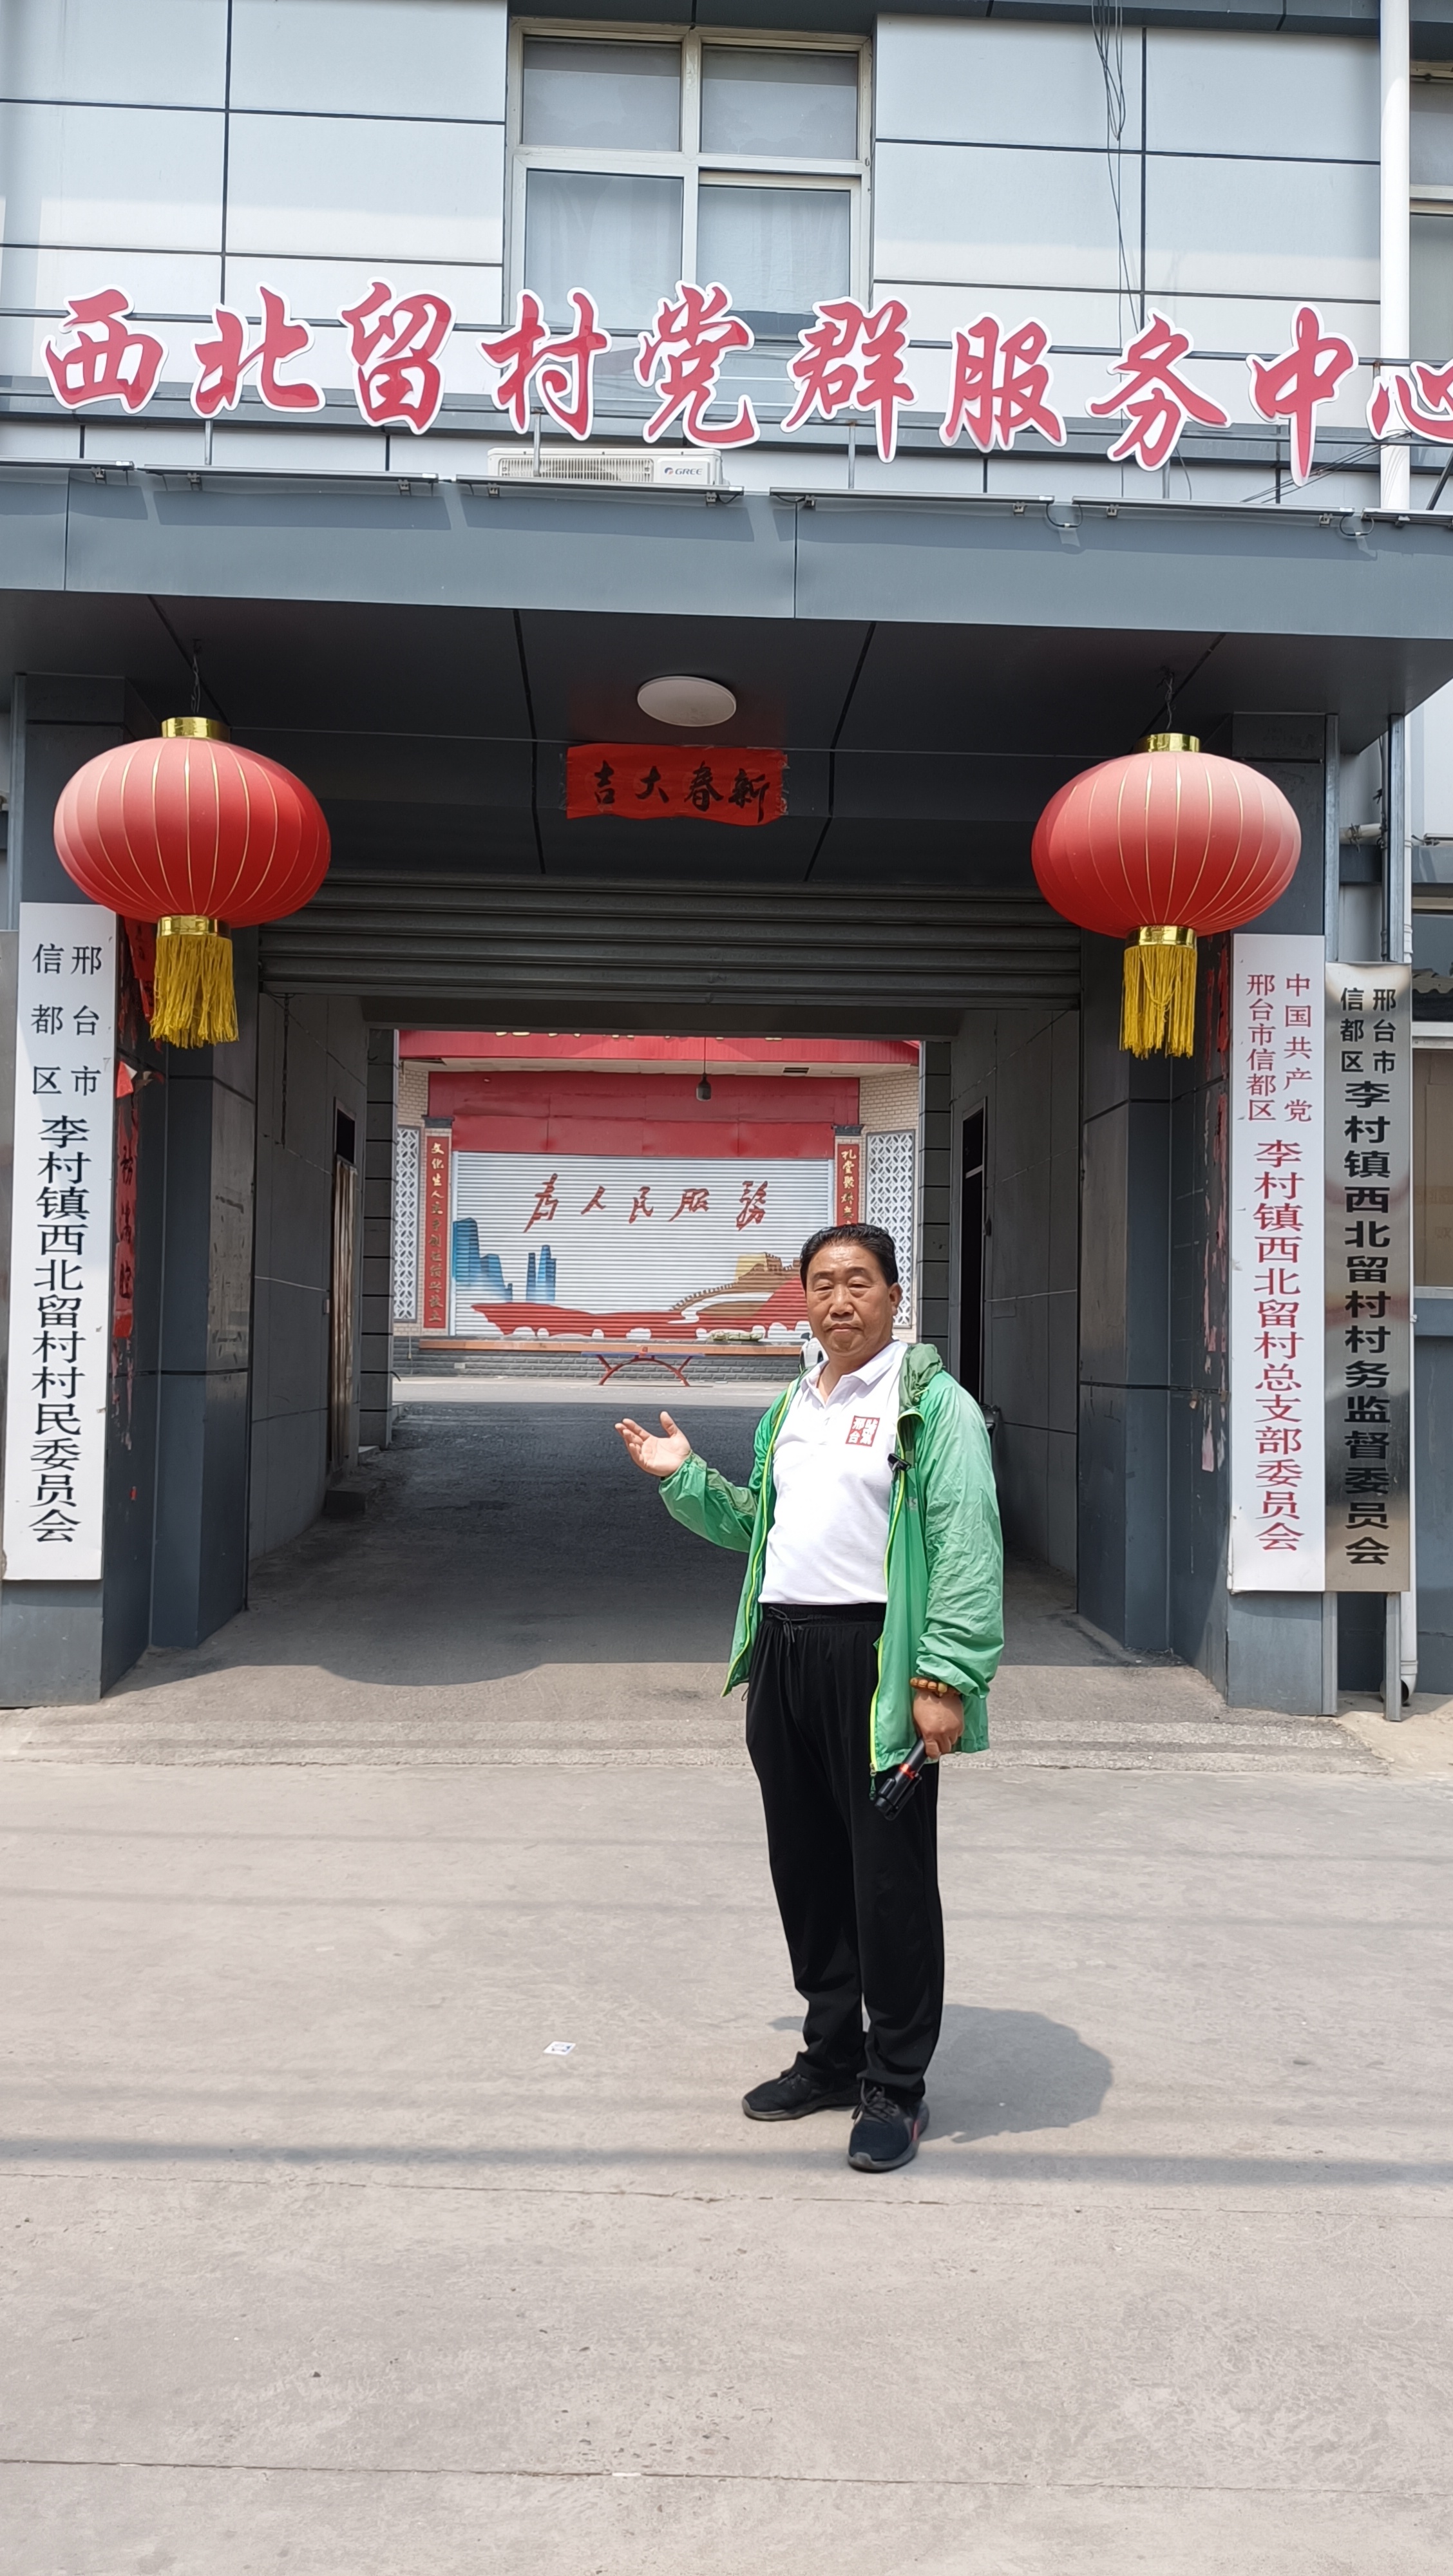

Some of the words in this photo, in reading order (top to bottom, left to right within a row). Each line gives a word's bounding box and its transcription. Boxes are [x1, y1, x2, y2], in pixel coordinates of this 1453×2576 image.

[45, 281, 1453, 480] 西北留村党群服务中心
[32, 942, 64, 1095] 信都区
[71, 945, 103, 1096] 邢台市
[1246, 973, 1277, 1121] 邢台市信都区
[1284, 973, 1313, 1122] 中国共产党
[1340, 987, 1364, 1072] 信都区
[1372, 987, 1396, 1074] 邢台市
[28, 1115, 91, 1542] 李村镇西北留村村民委员会
[1253, 1139, 1305, 1551] 李村镇西北留村总支部委员会
[1344, 1081, 1391, 1565] 李村镇西北留村村务监督委员会
